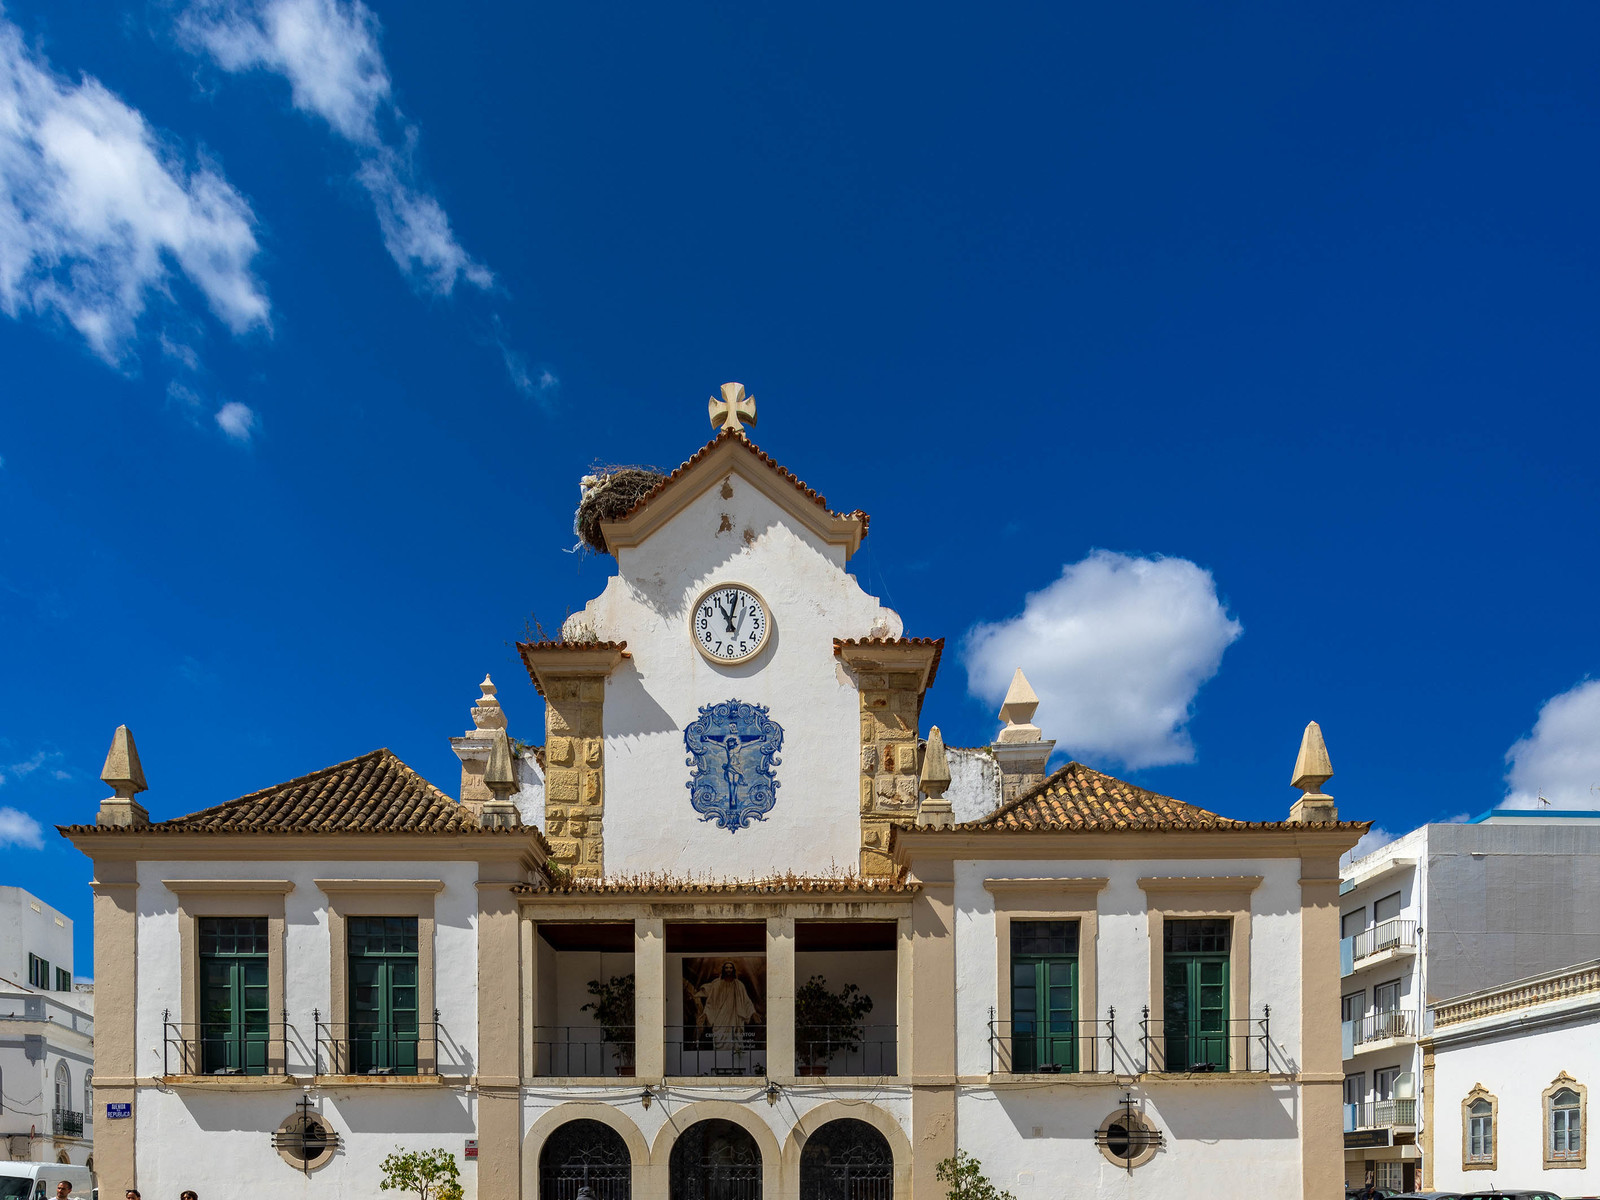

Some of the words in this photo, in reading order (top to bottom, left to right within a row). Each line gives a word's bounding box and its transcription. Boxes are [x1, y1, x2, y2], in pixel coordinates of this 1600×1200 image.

[714, 597, 721, 608] 11
[726, 592, 736, 604] 12
[741, 596, 745, 607] 1
[704, 606, 713, 617] 10
[749, 606, 756, 617] 2
[701, 619, 708, 630] 9
[753, 618, 760, 629] 3
[705, 632, 712, 642] 8
[749, 631, 756, 642] 4
[715, 641, 722, 652] 7
[727, 644, 734, 655] 6
[740, 641, 746, 652] 5
